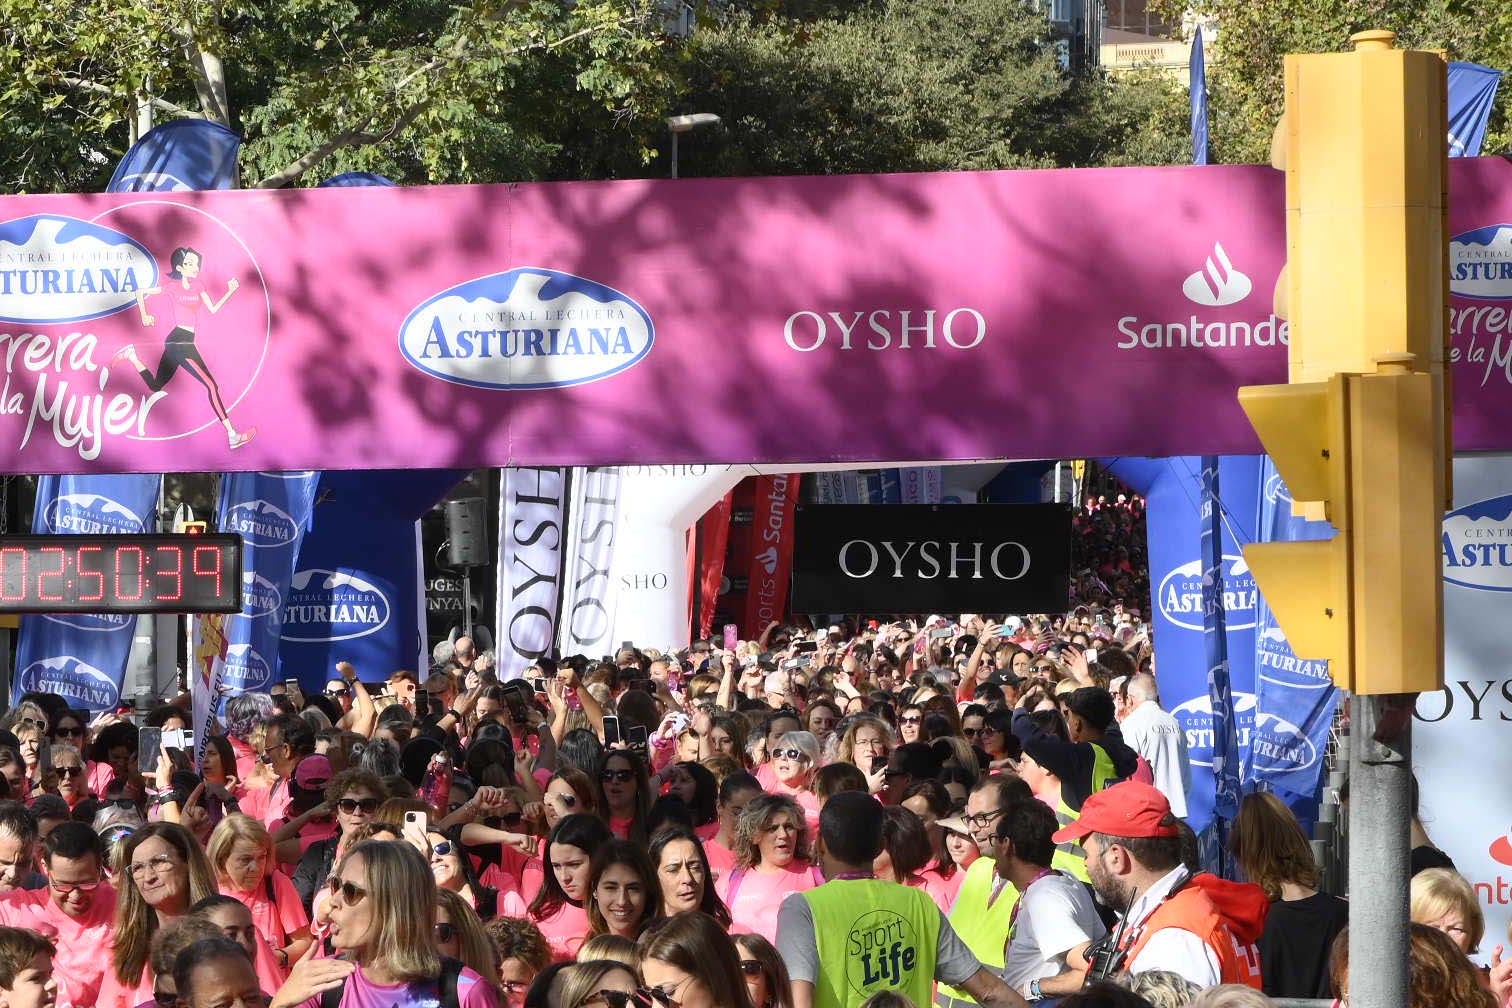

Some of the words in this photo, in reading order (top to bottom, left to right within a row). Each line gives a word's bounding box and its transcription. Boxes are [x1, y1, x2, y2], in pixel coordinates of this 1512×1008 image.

[61, 251, 134, 263] LECHERA
[458, 308, 536, 323] CENTRAL
[545, 308, 626, 321] LECHERA
[783, 306, 987, 352] OYSHO
[1117, 314, 1289, 349] Santande
[419, 315, 634, 360] ASTURIANA
[1467, 336, 1485, 363] la
[0, 376, 25, 415] la
[19, 366, 169, 461] Mujer
[763, 473, 788, 543] Santa
[0, 546, 221, 600] 02:50:39
[837, 539, 1031, 581] OYSHO
[429, 598, 464, 611] NYA
[26, 670, 111, 706] ASTURIANA
[850, 917, 905, 955] Sport
[861, 941, 915, 987] Life
